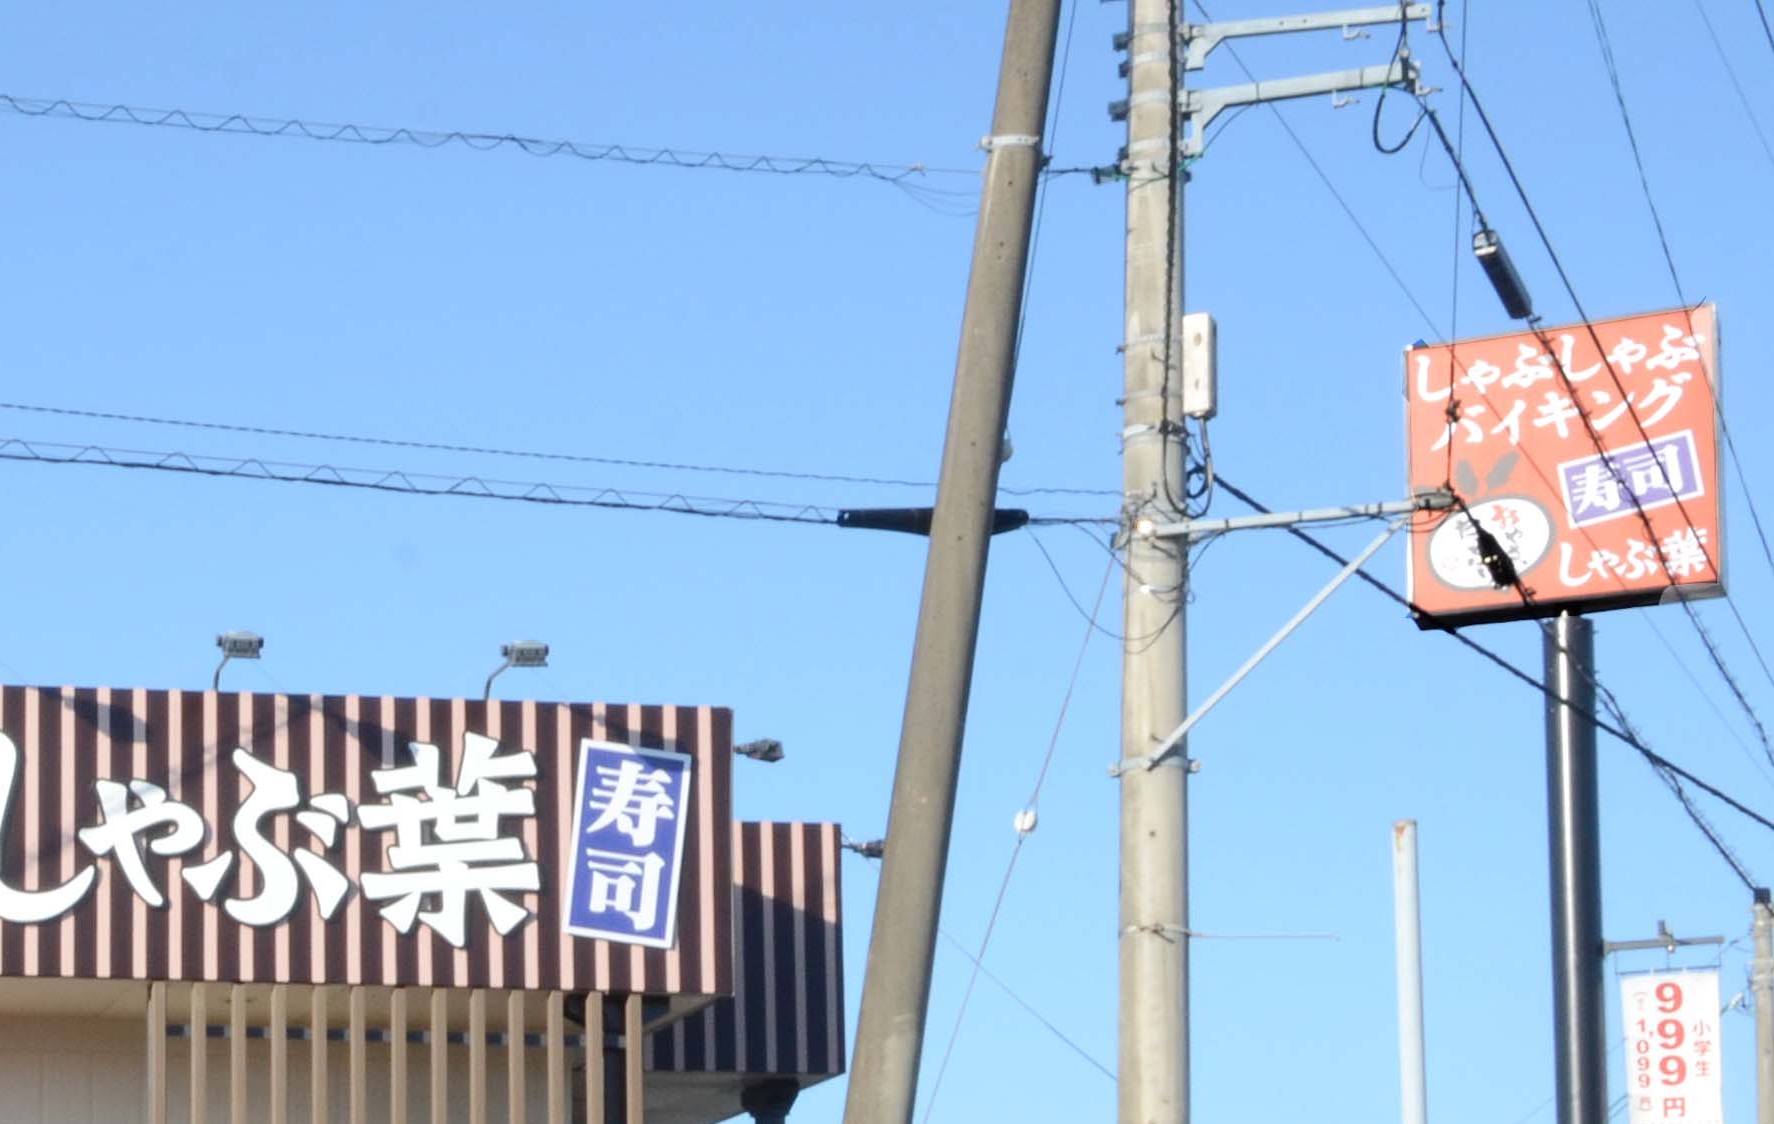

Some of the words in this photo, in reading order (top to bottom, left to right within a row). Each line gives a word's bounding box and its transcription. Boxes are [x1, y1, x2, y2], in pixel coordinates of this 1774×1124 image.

[1416, 325, 1707, 402] しゃぶしゃぶ
[1431, 371, 1693, 451] バイキング
[1571, 444, 1685, 515] 寿司
[1559, 527, 1709, 588] しゃぶ葉
[586, 759, 675, 932] 寿司
[1655, 981, 1688, 1119] 999円
[1692, 1019, 1713, 1078] 小学生
